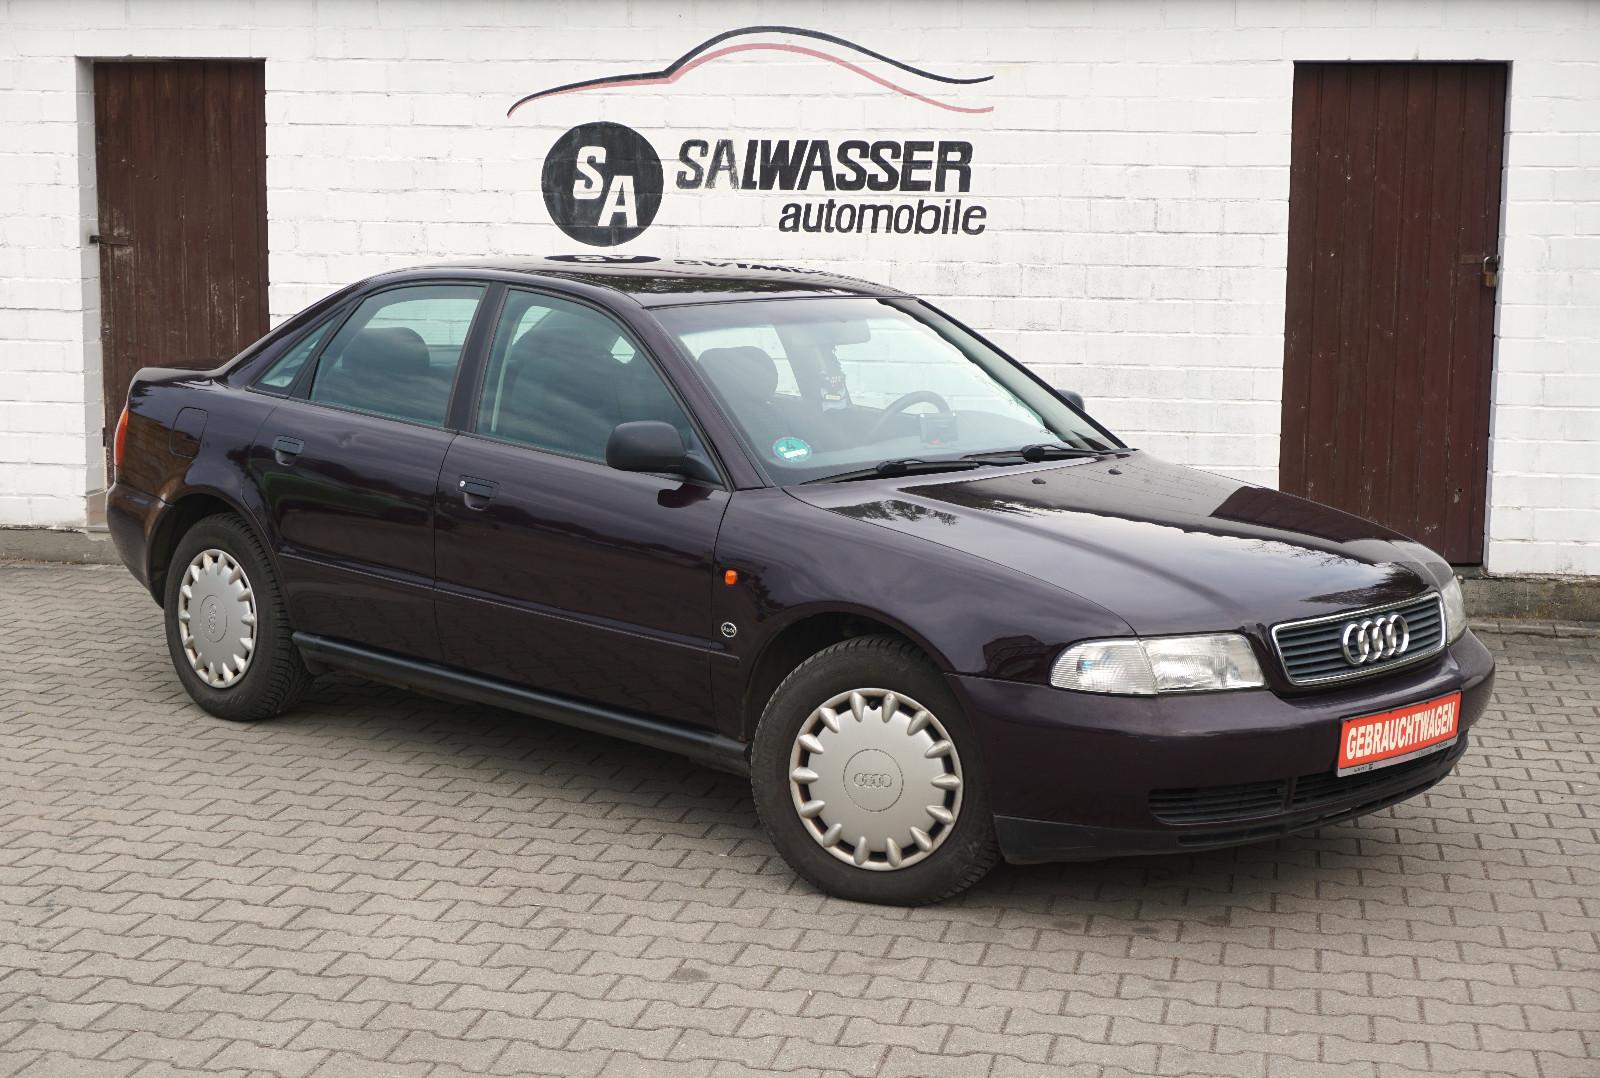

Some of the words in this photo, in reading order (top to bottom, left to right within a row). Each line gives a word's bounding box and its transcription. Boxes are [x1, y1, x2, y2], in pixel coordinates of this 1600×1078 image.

[572, 145, 638, 228] SA
[676, 139, 974, 193] SALWASSER
[778, 198, 988, 235] automobile
[1346, 702, 1456, 760] GEBRAUCHTWAGEN
